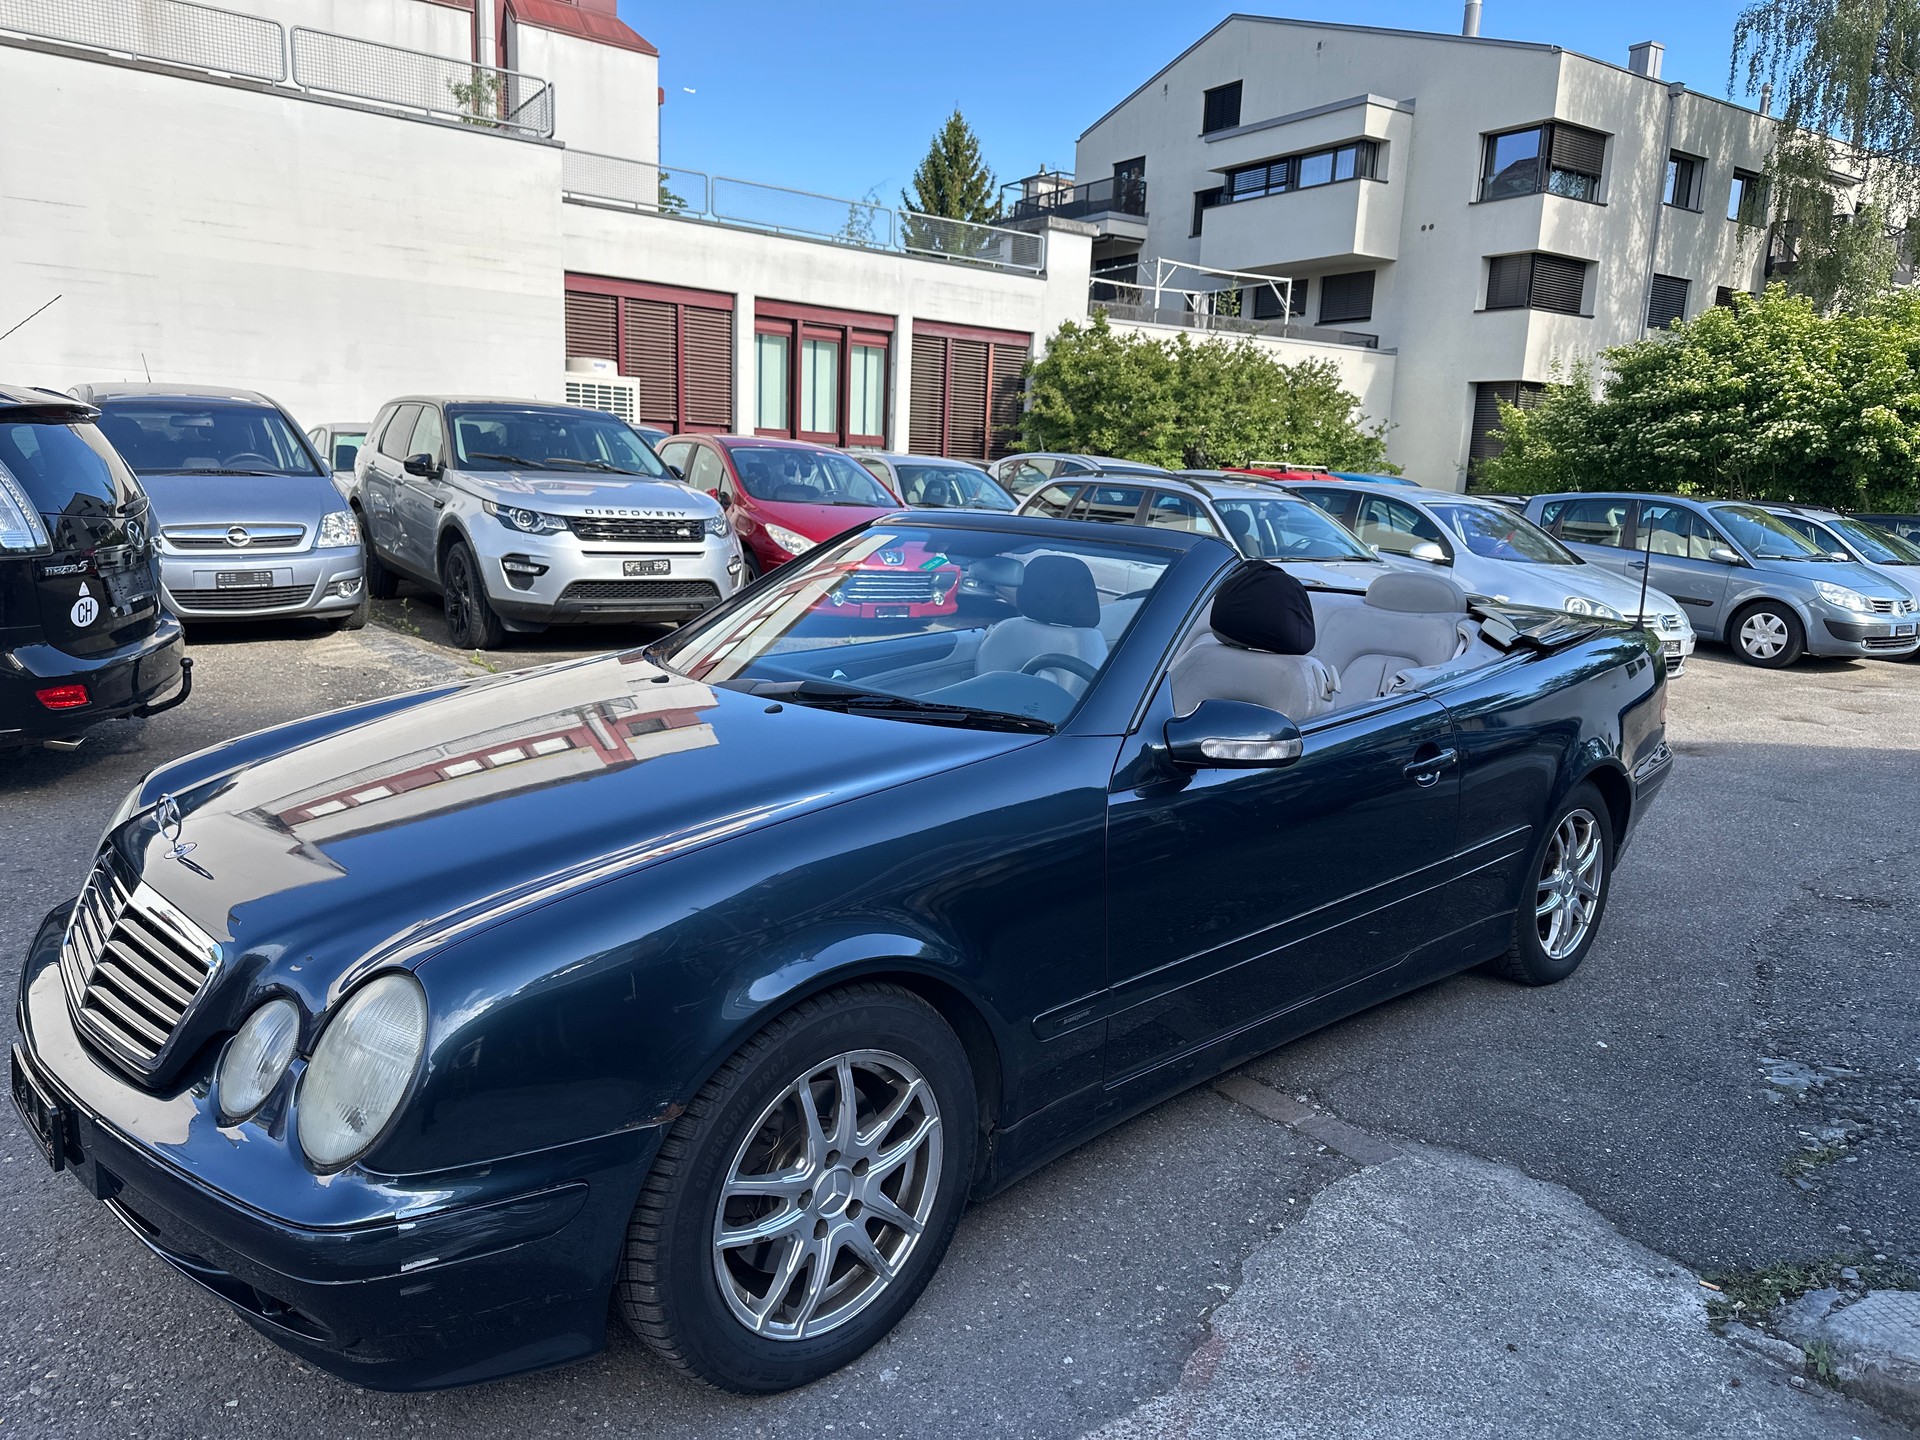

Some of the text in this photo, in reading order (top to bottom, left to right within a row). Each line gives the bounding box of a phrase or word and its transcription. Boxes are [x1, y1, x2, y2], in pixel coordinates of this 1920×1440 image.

[584, 508, 686, 517] DISCOVERY
[77, 600, 93, 624] CH
[695, 1093, 752, 1190] SUPERGRIP
[753, 1061, 780, 1093] PRO
